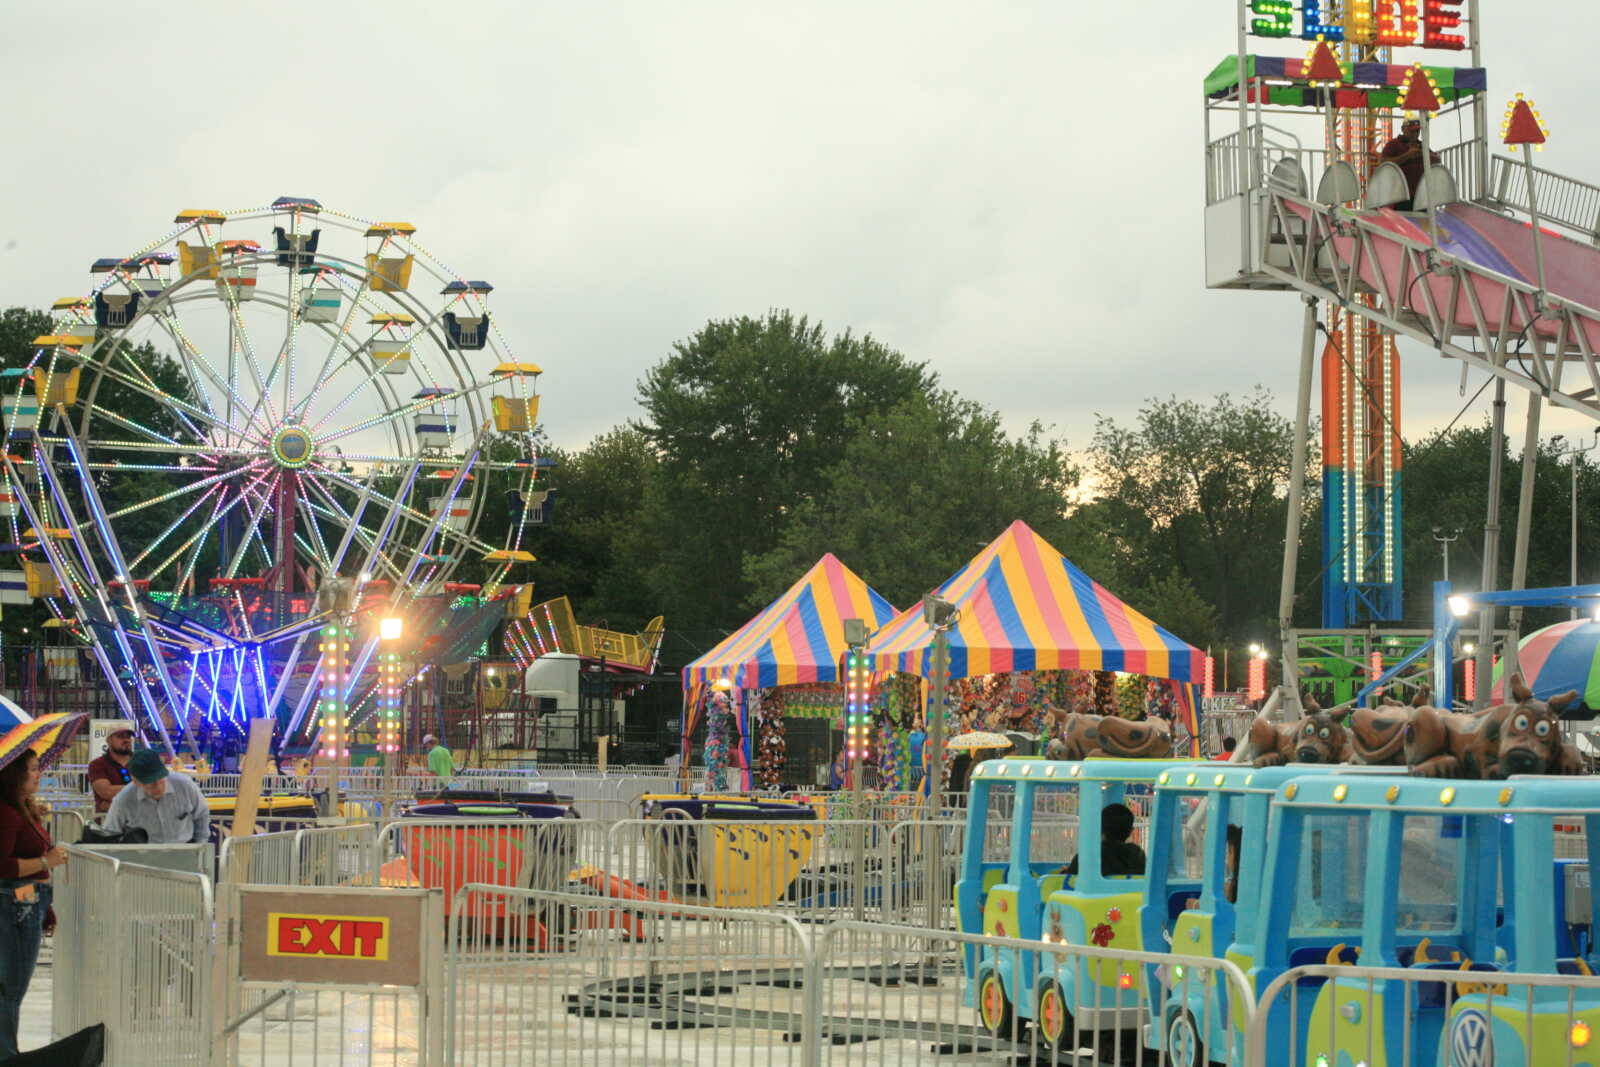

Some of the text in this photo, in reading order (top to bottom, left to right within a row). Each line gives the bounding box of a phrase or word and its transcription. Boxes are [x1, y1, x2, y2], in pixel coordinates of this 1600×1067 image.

[1251, 0, 1466, 50] SLIDE
[278, 917, 383, 957] EXIT
[1455, 1016, 1491, 1067] VW
